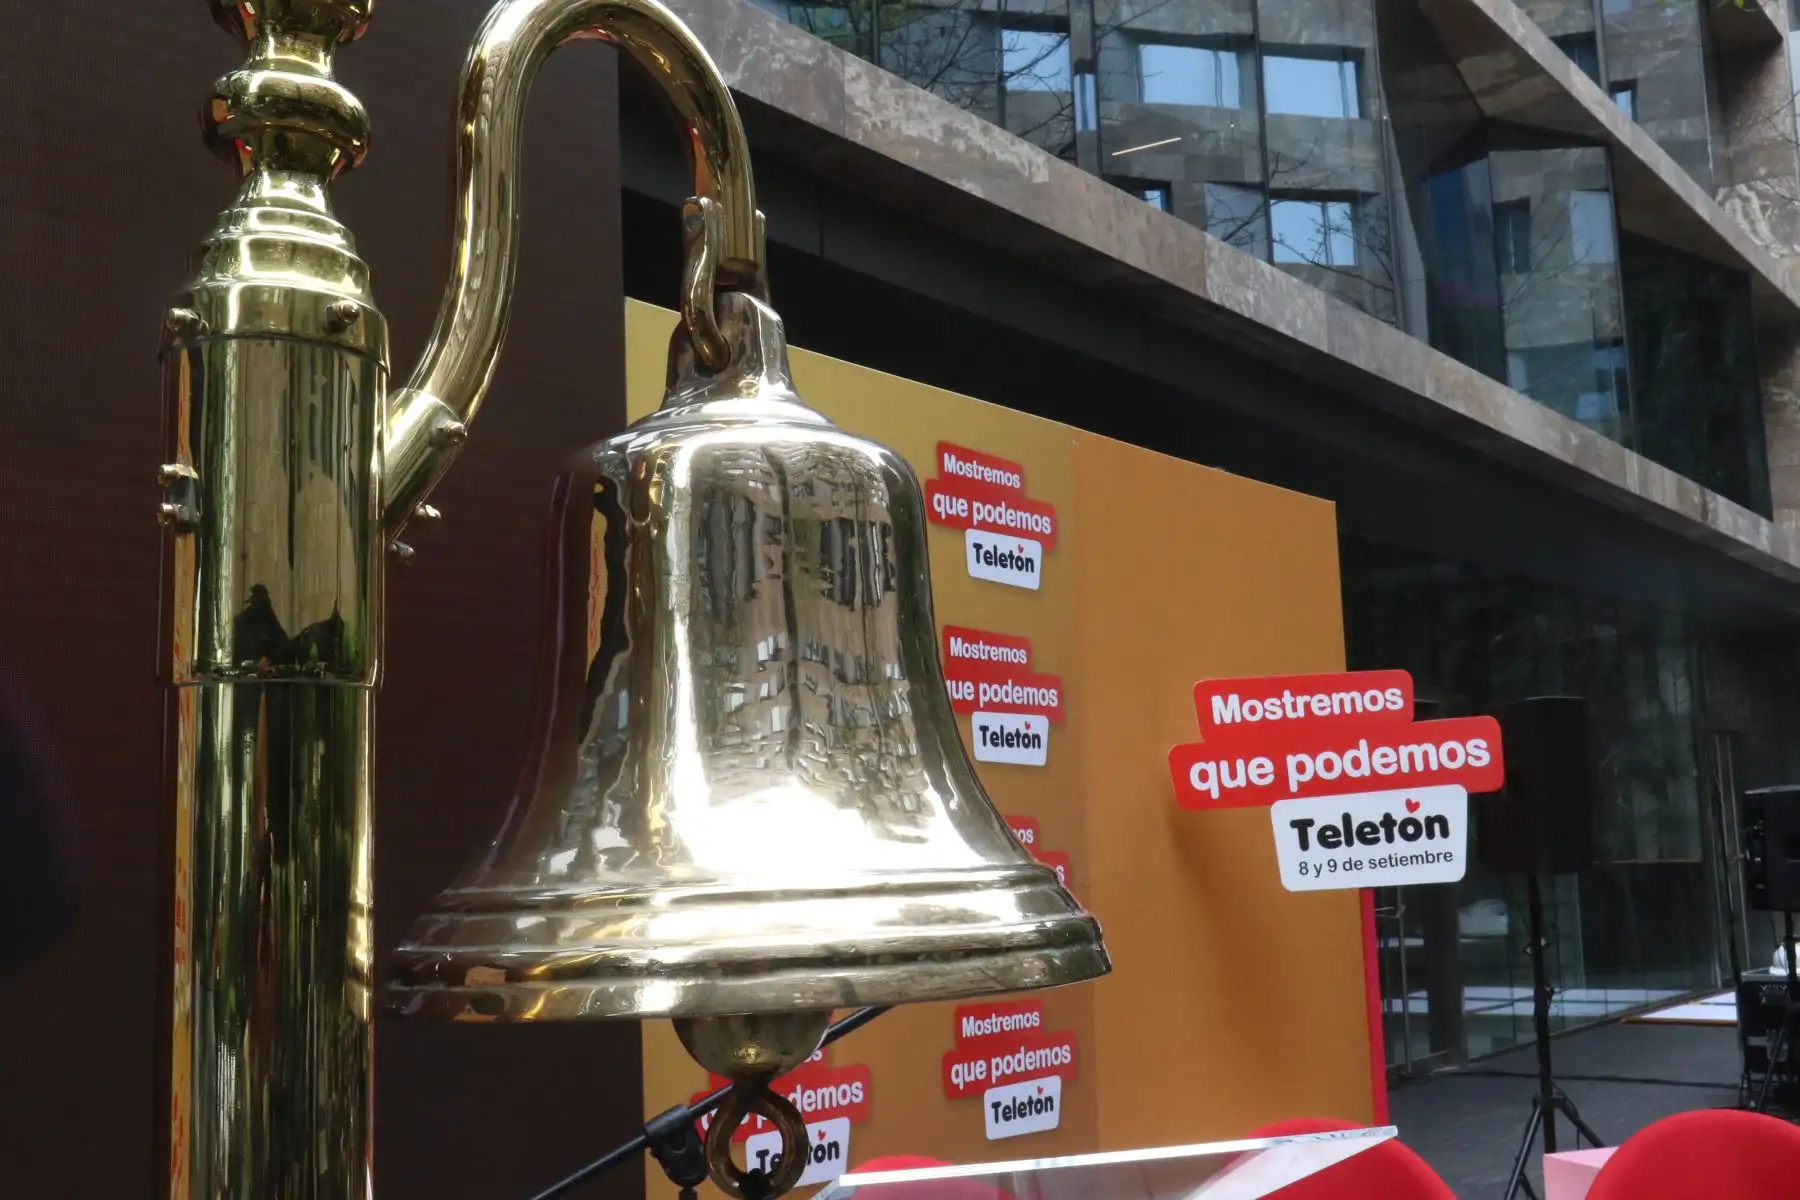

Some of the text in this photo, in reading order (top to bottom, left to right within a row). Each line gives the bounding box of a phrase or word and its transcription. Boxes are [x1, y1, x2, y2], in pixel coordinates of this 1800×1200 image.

[943, 452, 1021, 489] Mostremos
[933, 492, 1052, 535] que podemos
[949, 636, 1028, 665] Mostremos
[978, 678, 1059, 708] podemos
[1210, 686, 1405, 725] Mostremos
[1189, 738, 1491, 800] que podemos
[1298, 850, 1454, 878] 8 y 9 de setiembre
[961, 1011, 1041, 1038] Mostremos
[950, 1043, 1072, 1090] que podemos
